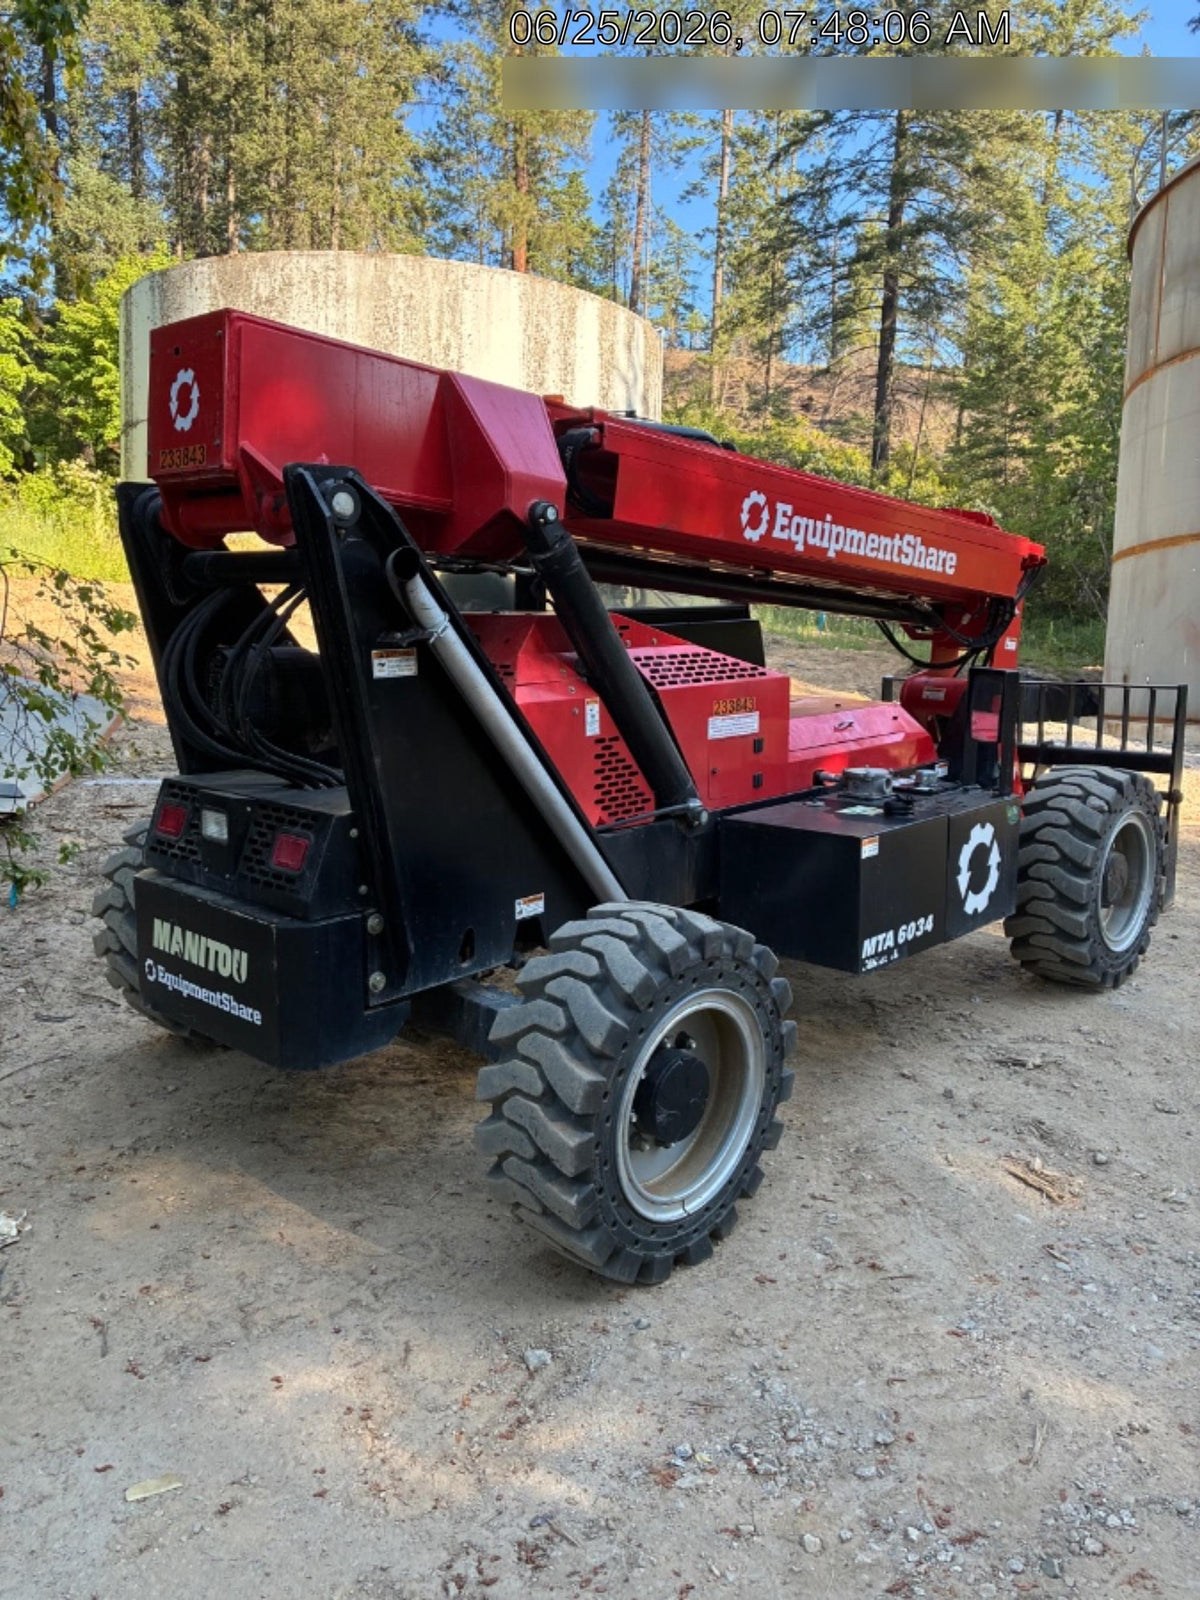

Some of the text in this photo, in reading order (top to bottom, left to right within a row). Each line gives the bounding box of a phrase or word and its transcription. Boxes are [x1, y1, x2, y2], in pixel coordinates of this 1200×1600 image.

[160, 445, 205, 469] 233843
[771, 502, 958, 575] EquipmentShare
[153, 917, 248, 984] MANITOU
[862, 914, 934, 959] MTA 6034
[157, 964, 262, 1025] EquipmentShare
